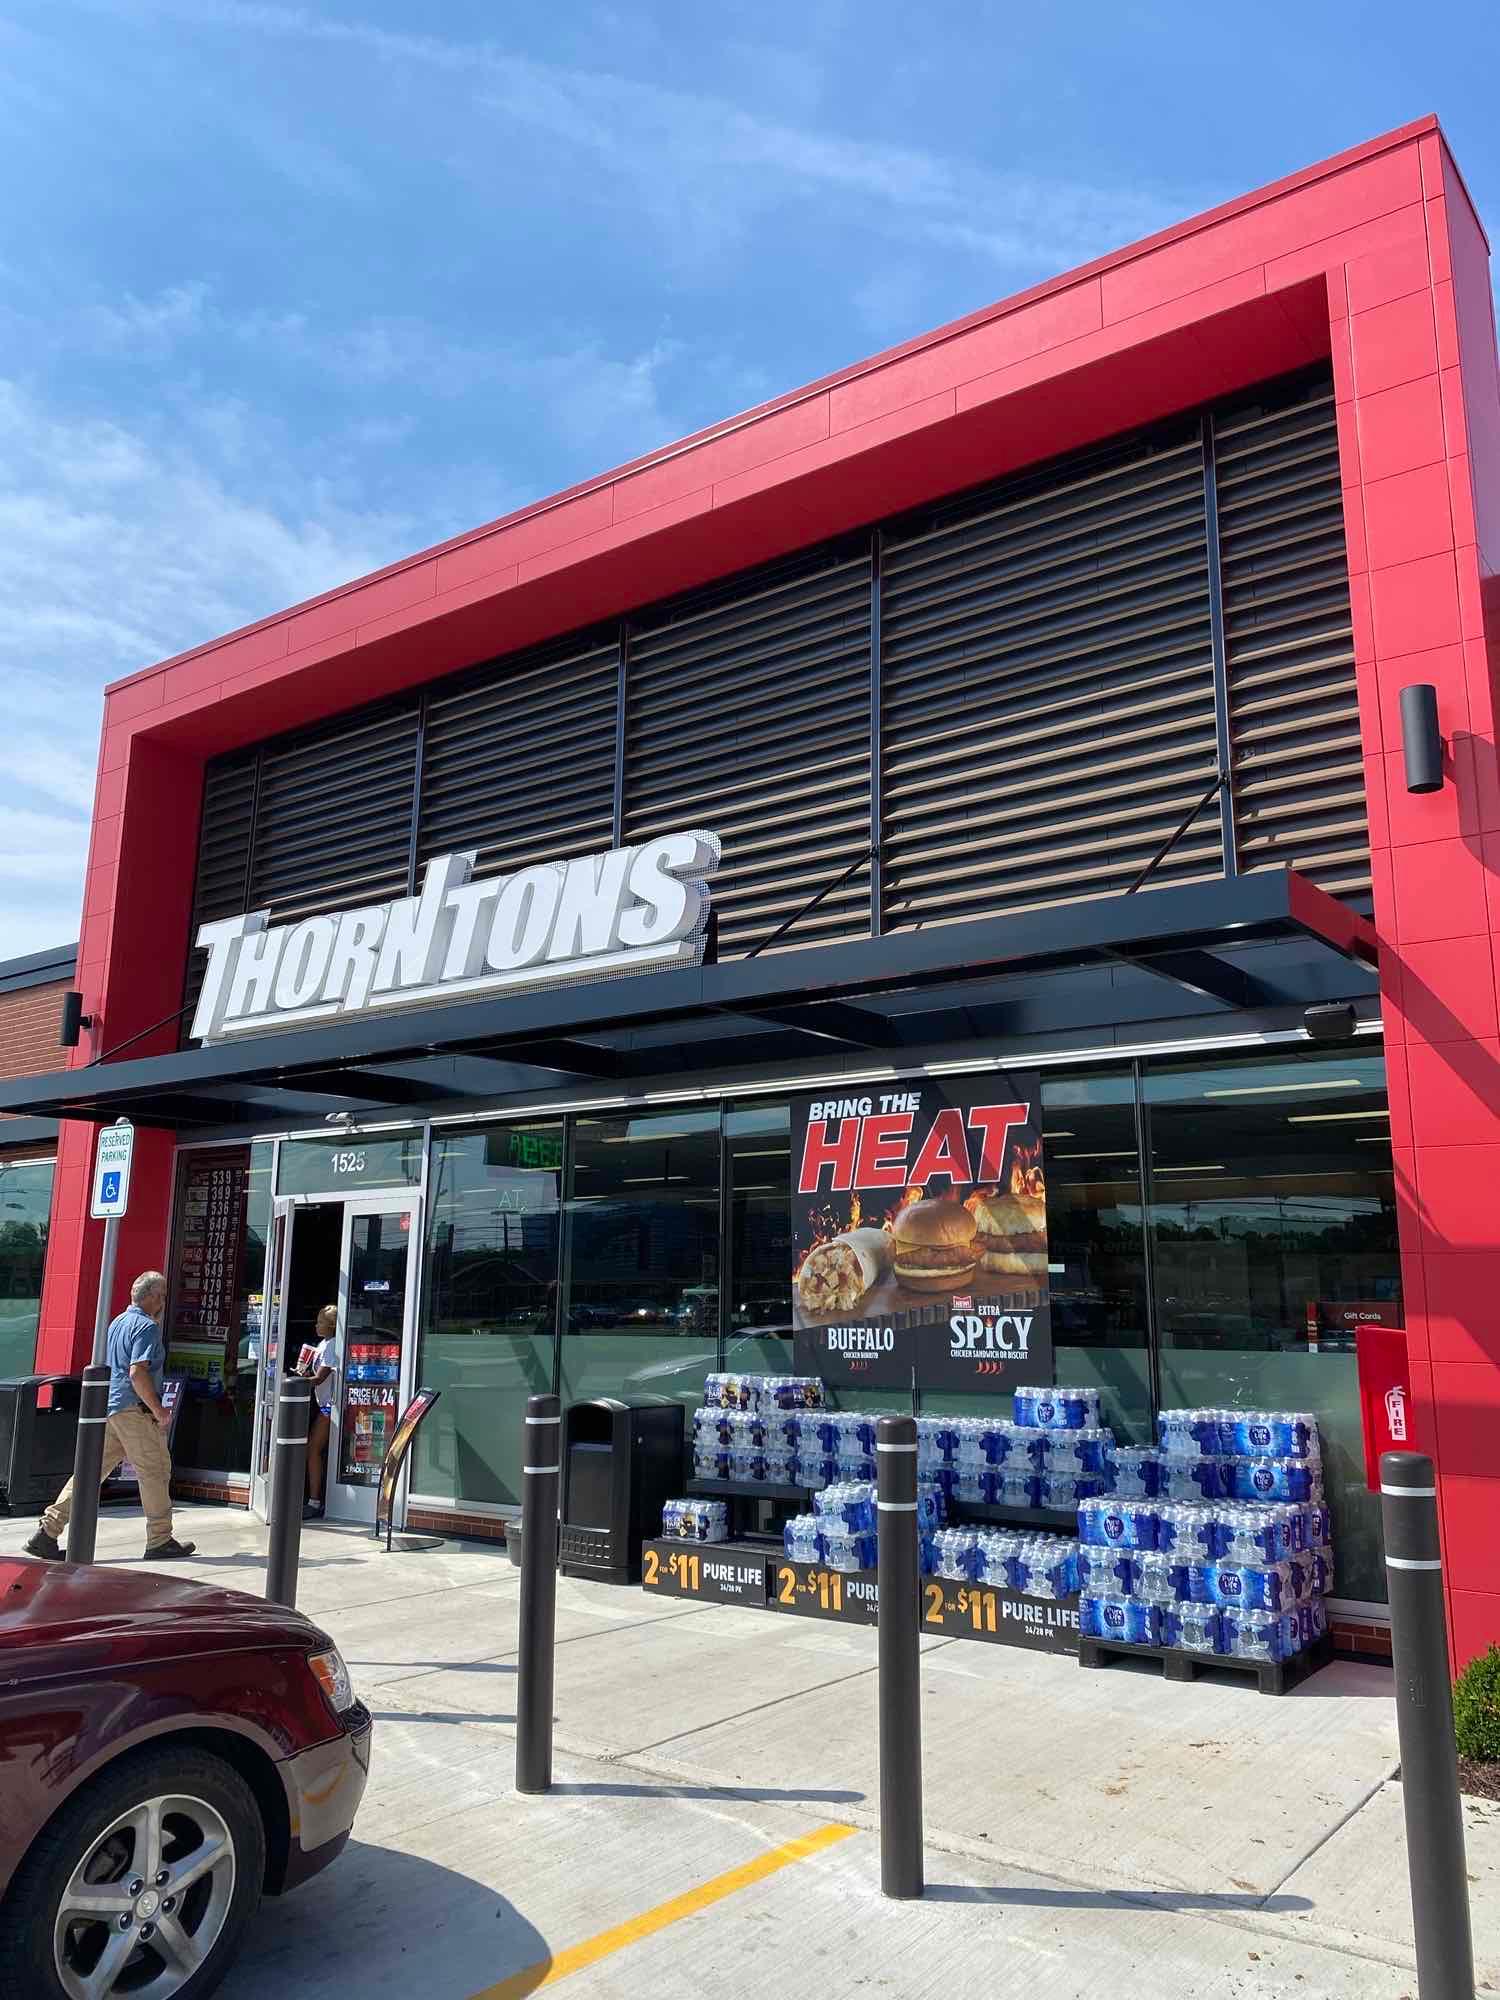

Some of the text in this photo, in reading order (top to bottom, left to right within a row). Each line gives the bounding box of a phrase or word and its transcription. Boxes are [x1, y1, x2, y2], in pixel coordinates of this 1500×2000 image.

[189, 831, 716, 1042] THORNTONS
[809, 1092, 922, 1120] BRING THE
[101, 1134, 131, 1147] RESERVED
[798, 1103, 1030, 1193] HEAT
[101, 1150, 127, 1162] PARKING
[331, 1152, 366, 1173] 1525
[978, 1305, 1000, 1316] EXTRA
[1344, 1312, 1381, 1320] Gift Cards
[827, 1327, 894, 1351] BUFFALO
[950, 1350, 1028, 1360] CHICKEN SANDWICH OR BISCUIT
[348, 1387, 371, 1398] PRICE
[1392, 1400, 1405, 1436] FIRE
[643, 1550, 659, 1585] 2
[669, 1553, 699, 1590] $11
[703, 1562, 762, 1586] PURE LIFE
[778, 1567, 796, 1605] 2
[807, 1570, 842, 1612] $11
[847, 1581, 879, 1601] PUR
[924, 1583, 997, 1632] 2 FOR $11
[1002, 1600, 1080, 1629] PURE LIFE
[1025, 1625, 1054, 1637] 24/28 PK
